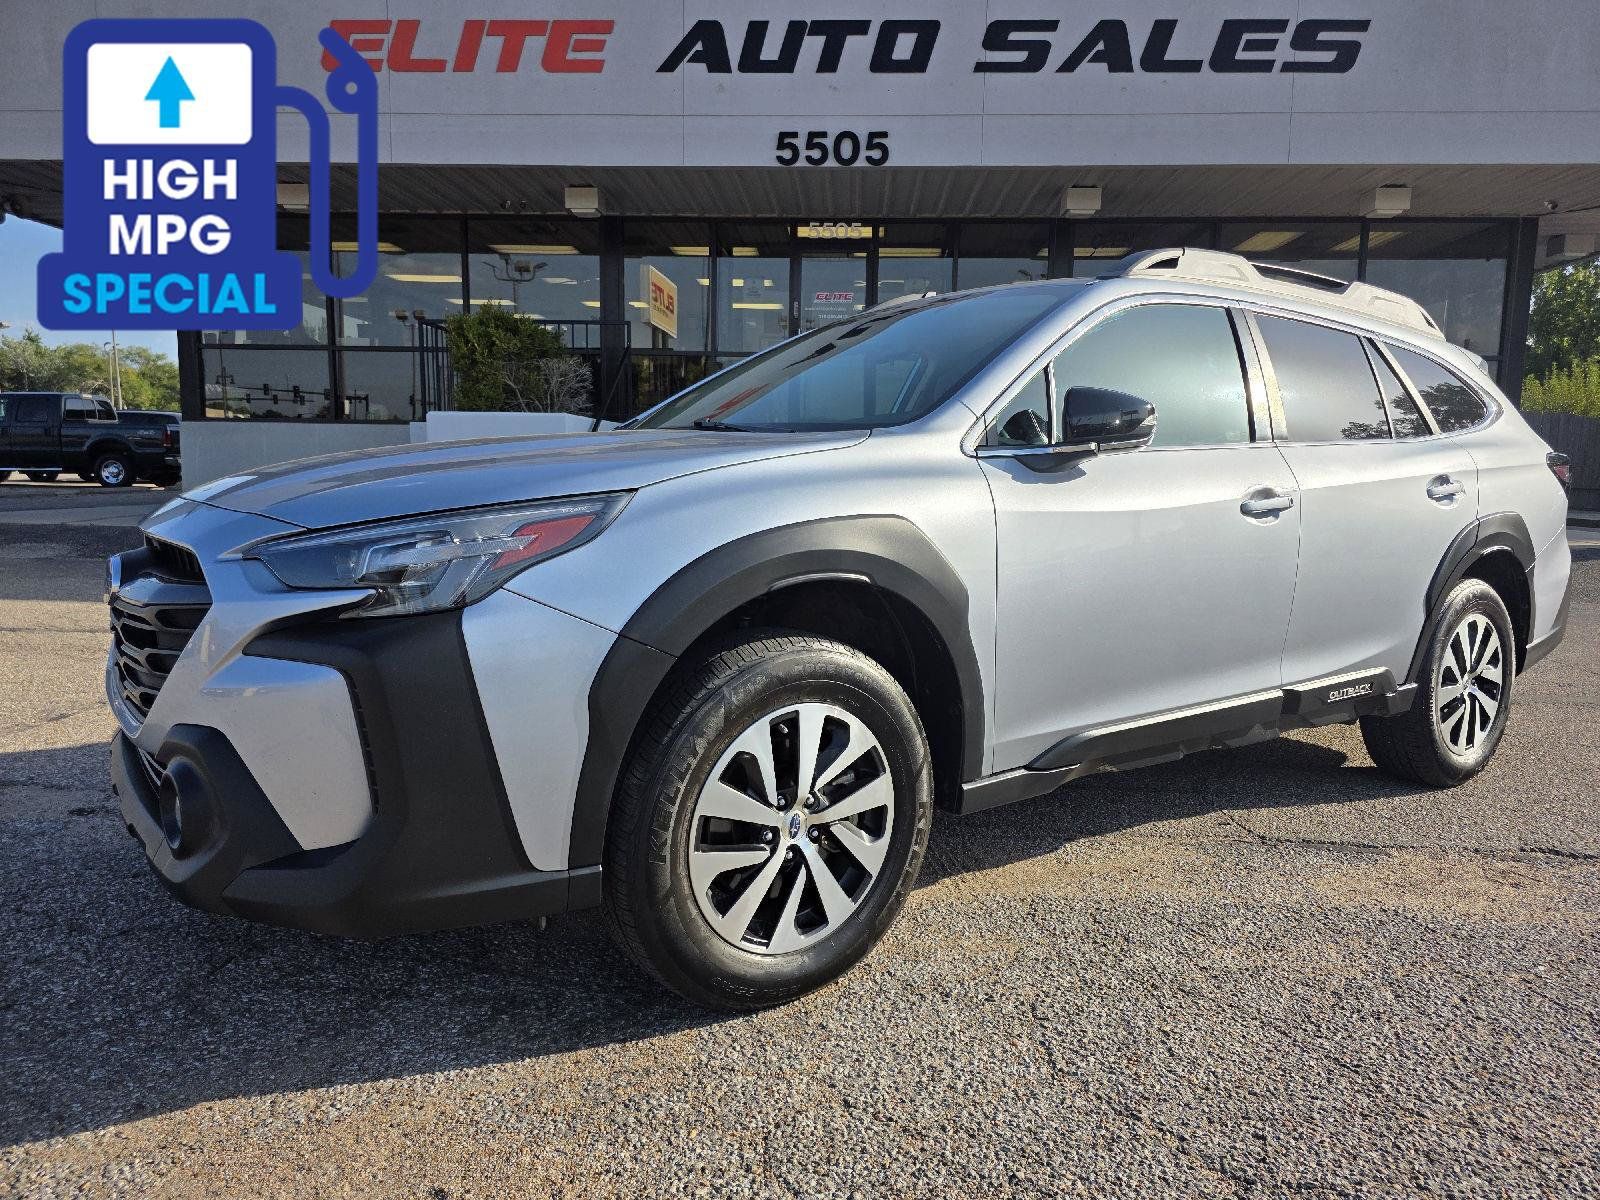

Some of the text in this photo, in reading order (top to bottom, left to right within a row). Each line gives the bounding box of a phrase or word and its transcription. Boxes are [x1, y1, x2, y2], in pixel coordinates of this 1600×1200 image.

[321, 19, 1371, 73] ELITE AUTO SALES
[776, 131, 889, 166] 5505
[808, 222, 862, 239] 5505
[1329, 683, 1372, 700] OUTBACK
